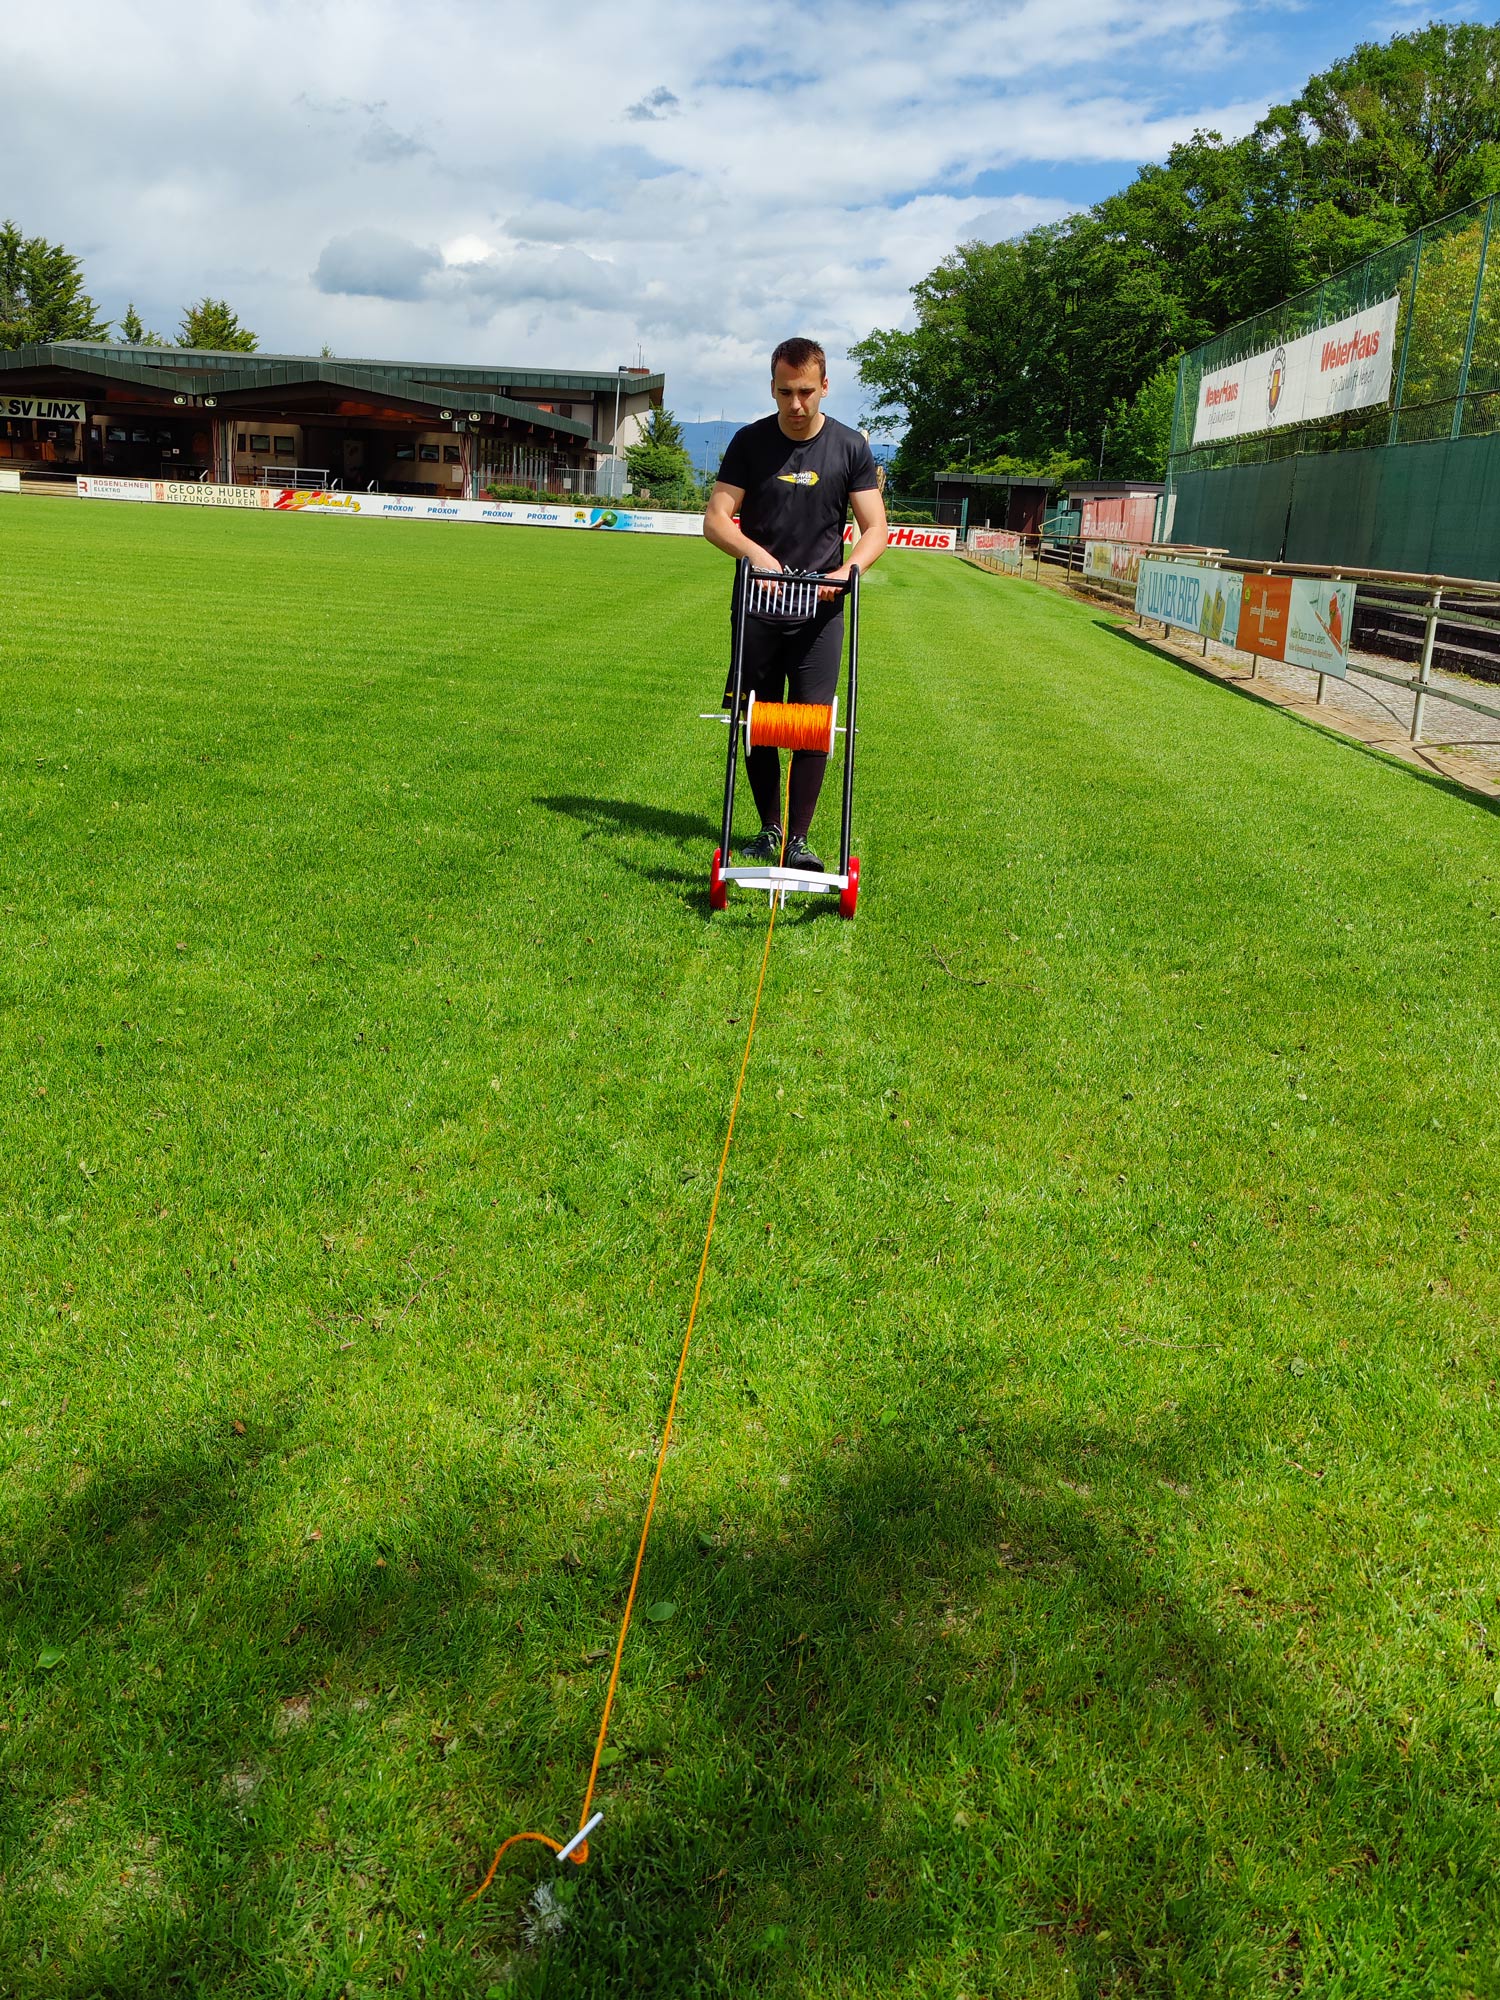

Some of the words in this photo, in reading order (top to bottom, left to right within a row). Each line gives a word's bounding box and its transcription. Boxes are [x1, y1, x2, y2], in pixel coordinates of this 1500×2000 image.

[1321, 329, 1380, 372] WeberHaus
[8, 399, 33, 416] SV
[36, 402, 80, 419] LINX
[93, 479, 149, 489] ROSENLEHNER
[168, 484, 213, 496] GEORG
[218, 488, 256, 498] HUBER
[167, 494, 234, 505] HEIZUNGSBAU
[238, 499, 259, 507] KEHL
[287, 491, 361, 512] Schulz
[383, 504, 414, 512] PROXON
[427, 507, 458, 515] PROXON
[482, 510, 513, 518] PROXON
[527, 513, 558, 521] PROXON
[1147, 571, 1177, 619] ULMER
[1177, 575, 1200, 626] BIER
